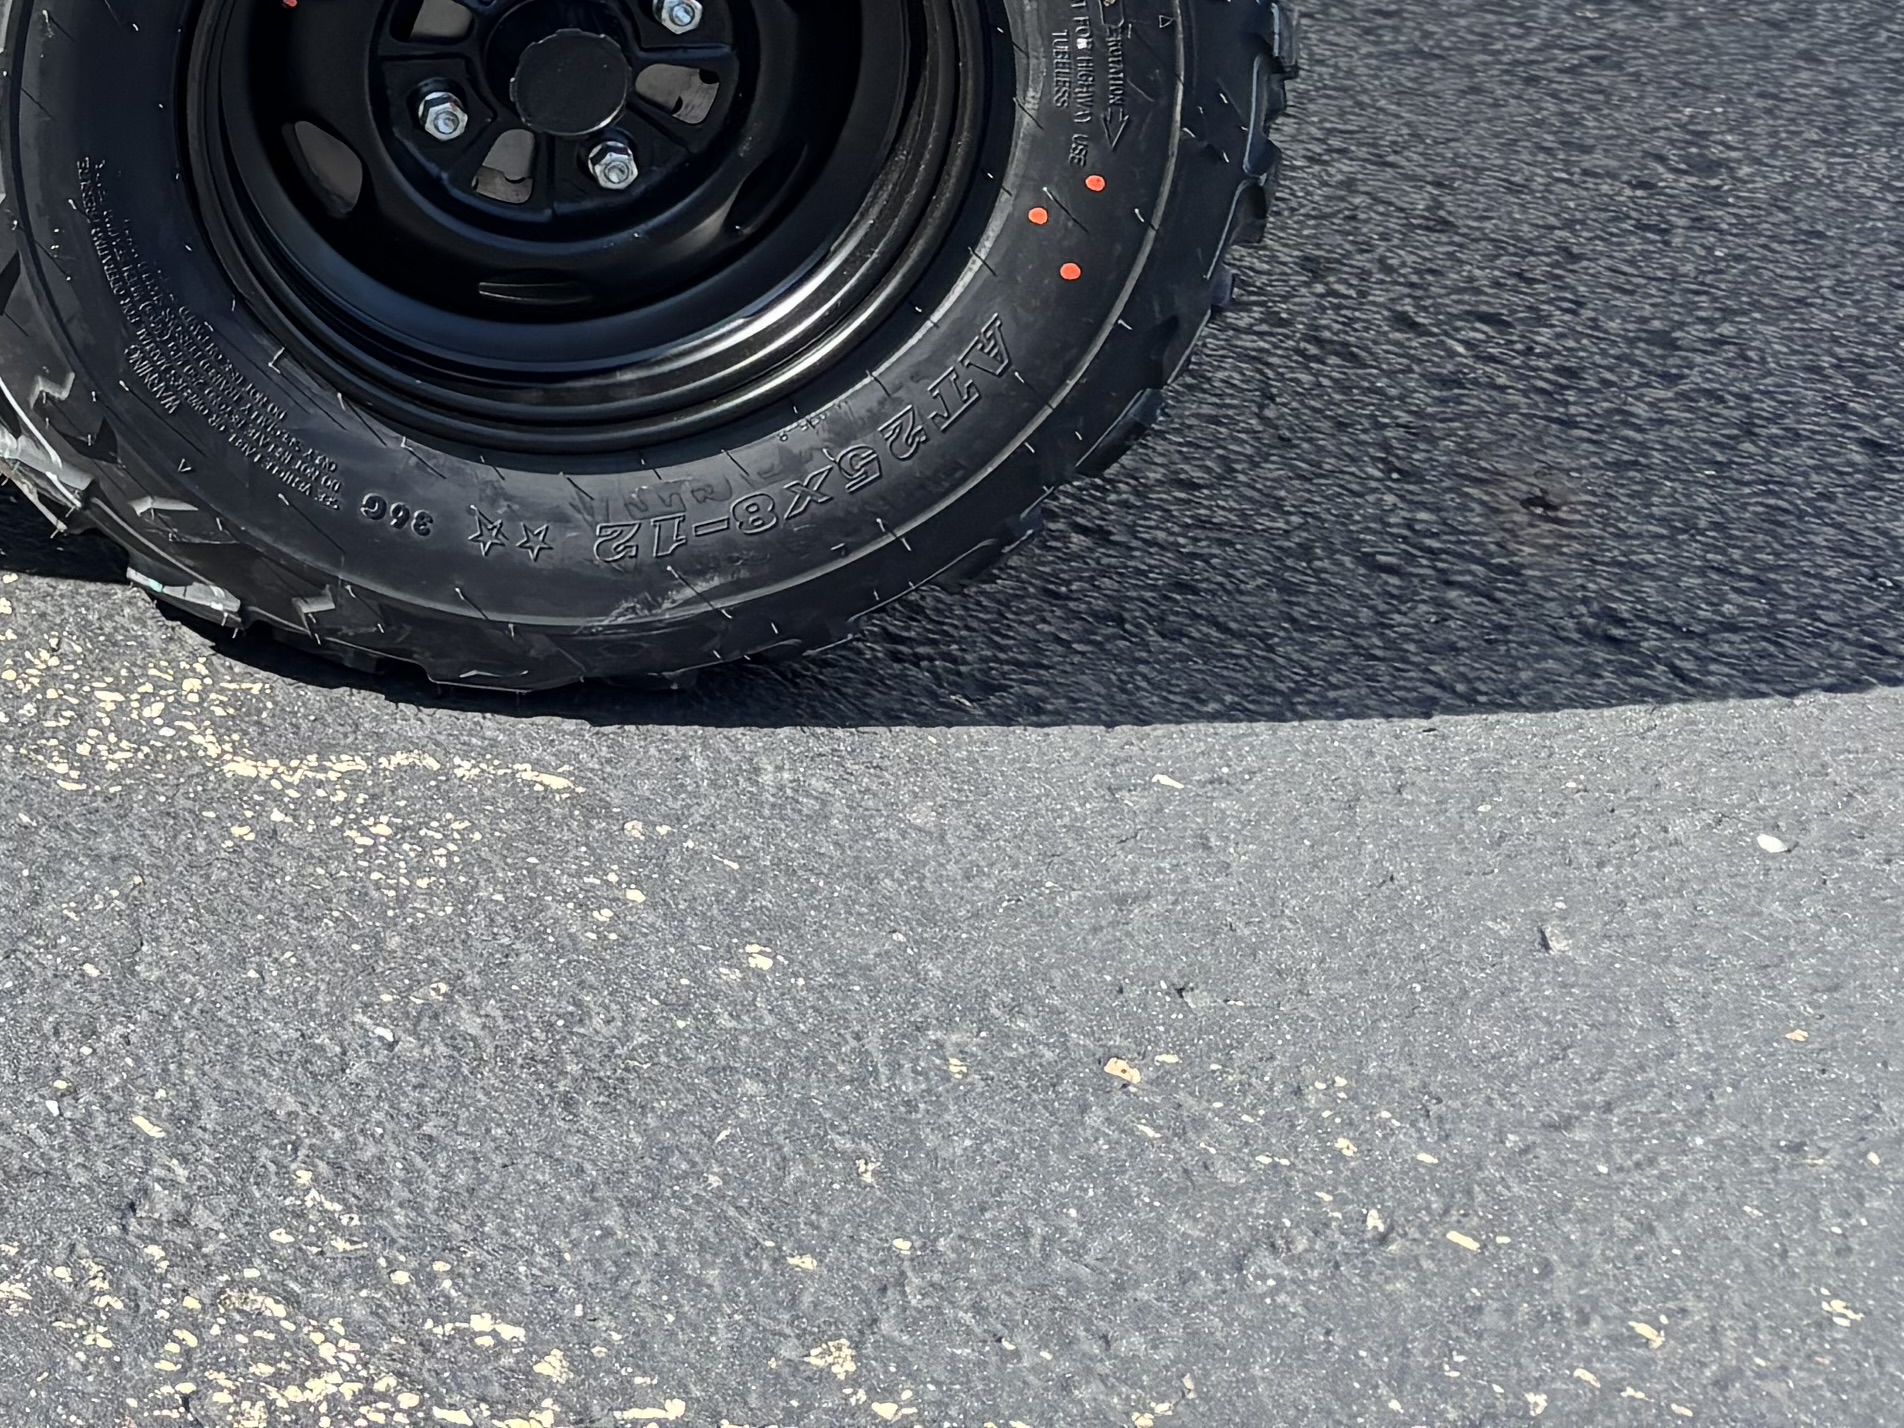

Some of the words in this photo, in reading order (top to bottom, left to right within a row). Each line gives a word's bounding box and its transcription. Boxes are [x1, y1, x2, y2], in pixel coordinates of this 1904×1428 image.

[1049, 28, 1071, 109] TUBELESS
[1071, 54, 1093, 126] HIGHWAY
[1105, 34, 1123, 106] ROTATION
[1066, 132, 1089, 169] USE
[123, 345, 183, 415] WARNING
